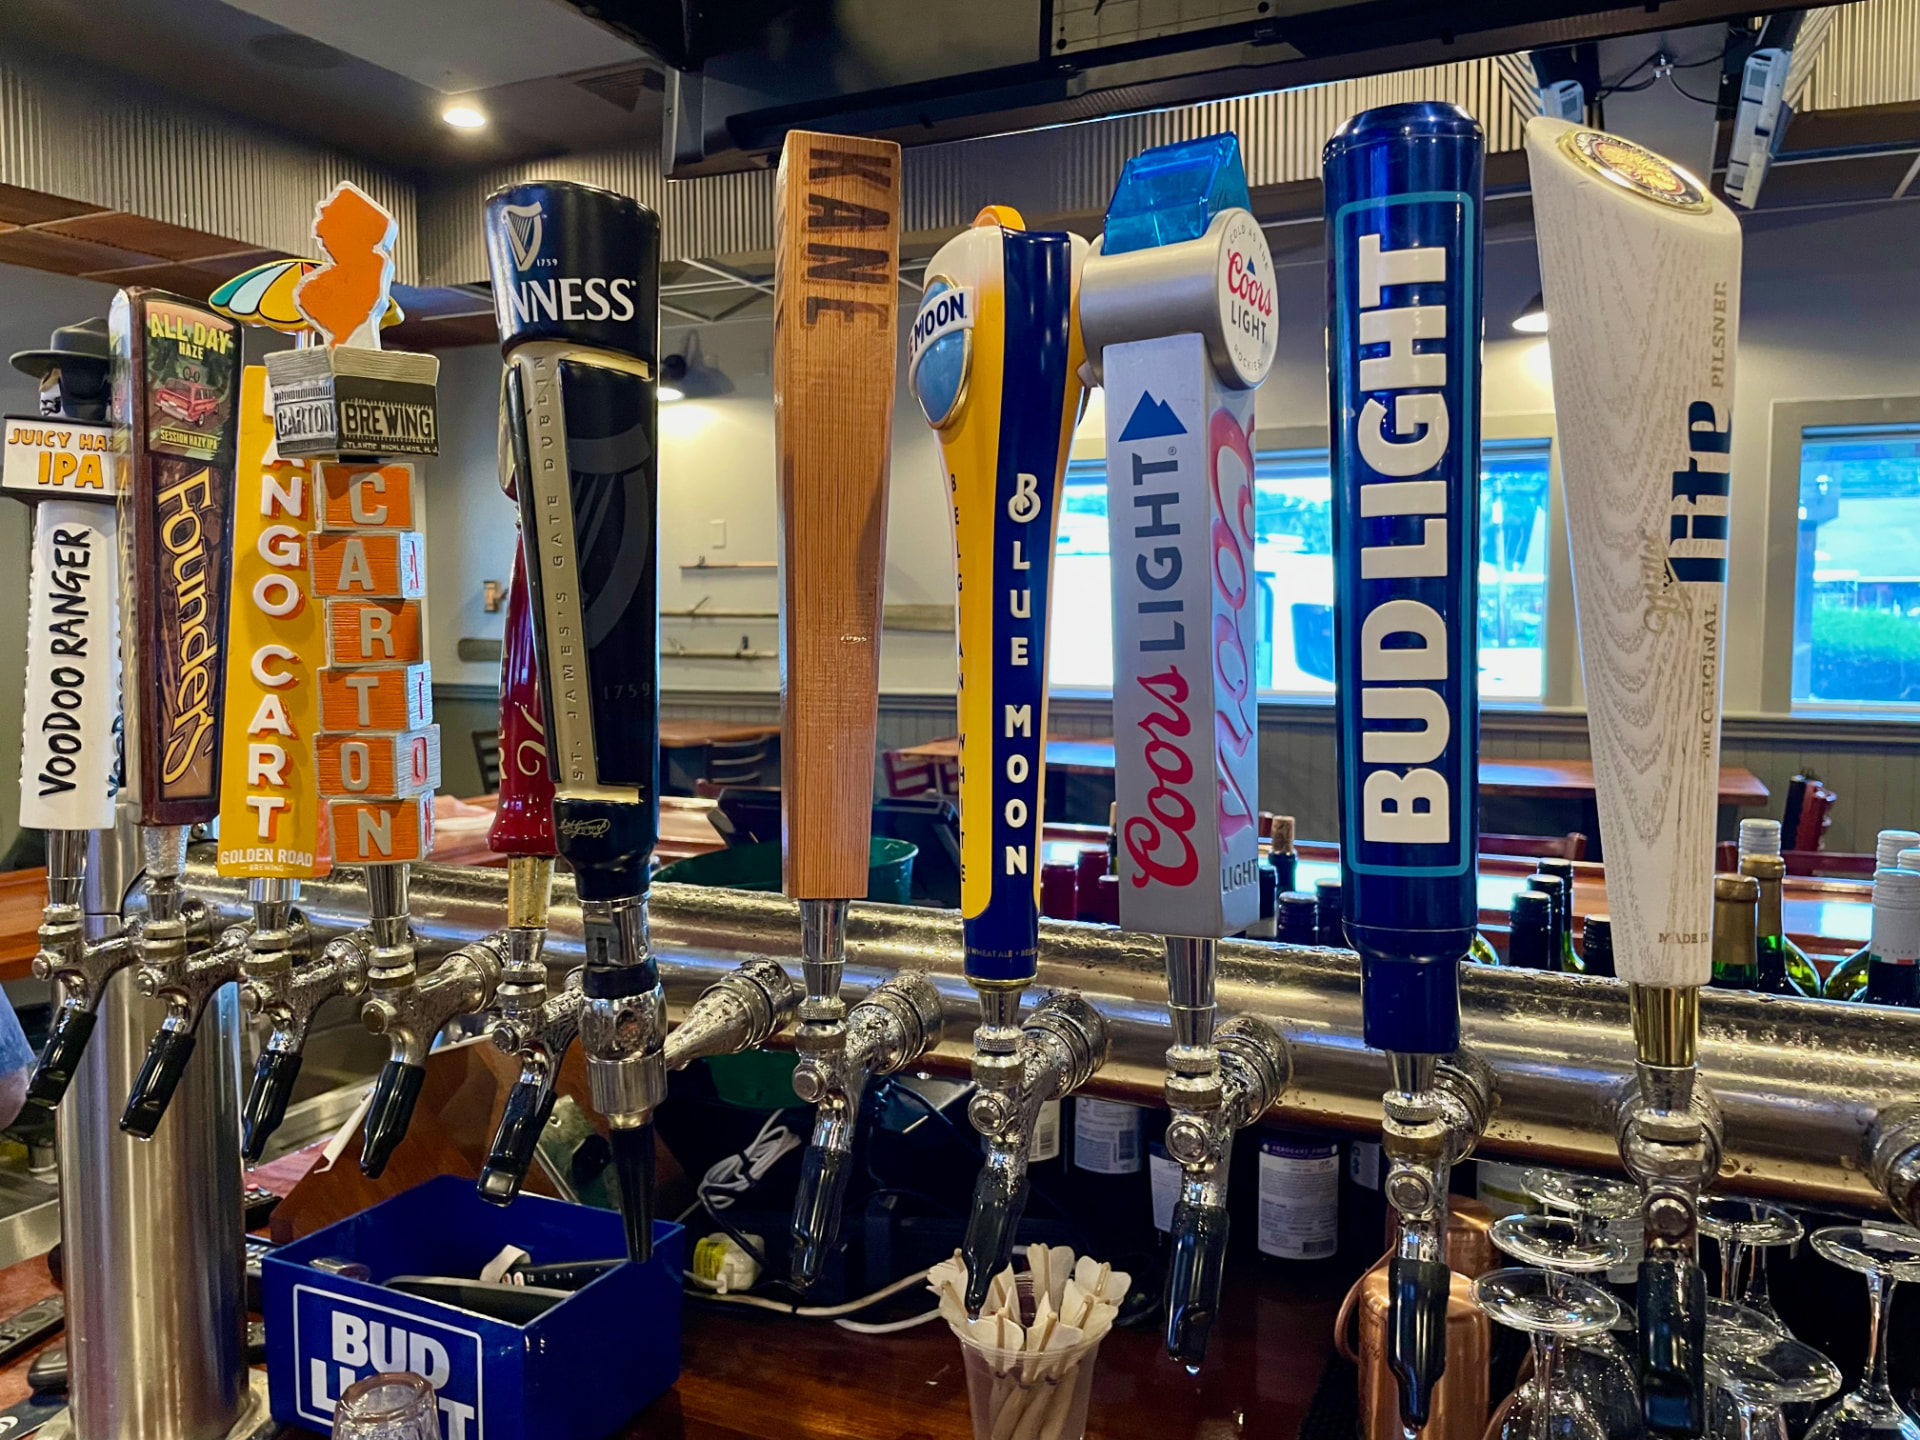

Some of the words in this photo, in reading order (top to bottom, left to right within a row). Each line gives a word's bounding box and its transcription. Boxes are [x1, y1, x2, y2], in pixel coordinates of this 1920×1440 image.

[536, 258, 558, 267] 1759
[806, 147, 892, 331] KANE
[914, 292, 965, 353] MOON
[1227, 247, 1272, 317] Coors
[1231, 300, 1267, 344] LIGHT
[151, 313, 188, 342] ALL
[193, 321, 230, 355] DAY
[178, 341, 204, 360] HAZE
[1711, 281, 1727, 389] PILSNER
[8, 428, 72, 448] JUICY
[160, 429, 188, 444] SESSION
[189, 434, 206, 448] HAZY
[206, 437, 218, 450] IPA
[277, 402, 334, 437] CARTON
[345, 402, 432, 440] BREWING
[534, 356, 557, 471] DUBLIN
[1357, 233, 1450, 580] LIGHT
[38, 451, 104, 489] IPA
[547, 495, 565, 569] GATE
[1007, 473, 1041, 666] BLUE
[1132, 452, 1186, 652] LIGHT
[48, 528, 92, 657] RANGER
[157, 468, 221, 786] Founders
[338, 473, 396, 859] CARTON
[556, 591, 578, 720] JAMES'S
[603, 681, 651, 700] 1759
[38, 666, 86, 798] VOODOO
[246, 644, 299, 839] CART
[1361, 599, 1450, 844] BUD
[1004, 704, 1032, 876] MOON
[1124, 664, 1199, 889] Coors
[220, 847, 274, 866] GOLDEN
[278, 848, 314, 868] ROAD
[249, 863, 285, 872] BREWING
[1222, 863, 1258, 895] LIGHT
[332, 1310, 450, 1391] BUD
[310, 1357, 476, 1440] LIT
